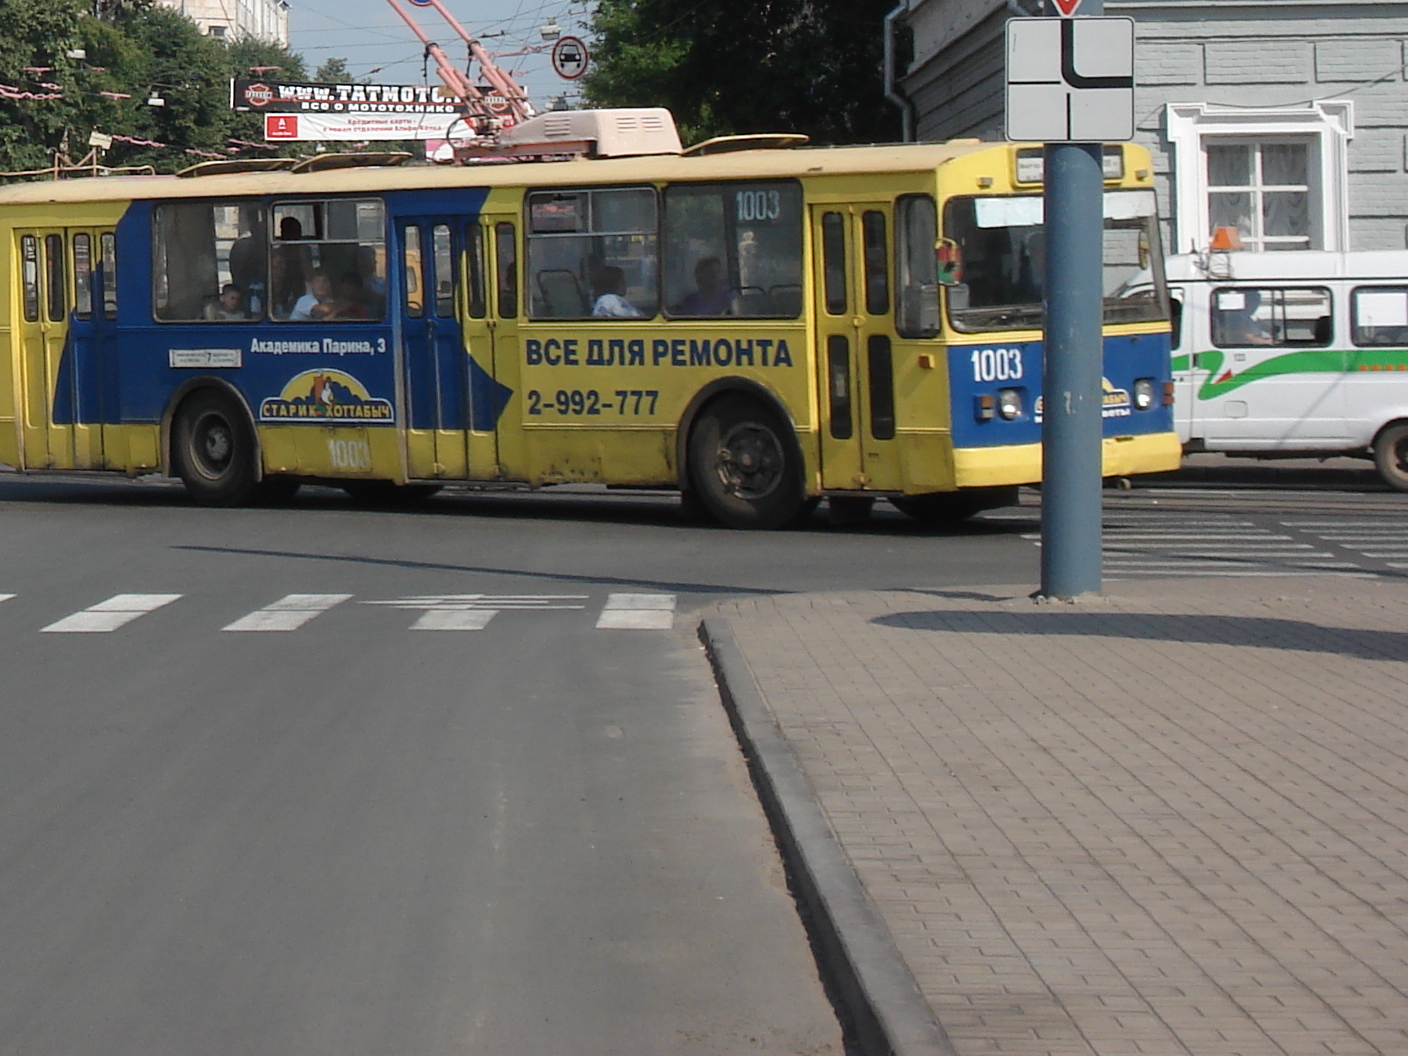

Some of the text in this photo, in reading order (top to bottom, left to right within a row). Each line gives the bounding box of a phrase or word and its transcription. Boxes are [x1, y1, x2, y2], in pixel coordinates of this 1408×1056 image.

[736, 190, 780, 220] 1003
[251, 338, 386, 356] Академика Парина, 3
[526, 339, 793, 367] ВСЕ ДЛЯ РЕМОНТА
[971, 348, 1023, 382] 1003
[263, 404, 390, 418] СТАРИК ХОТТАБЫЧ
[527, 390, 659, 416] 2-992-777
[328, 439, 370, 468] 1003
